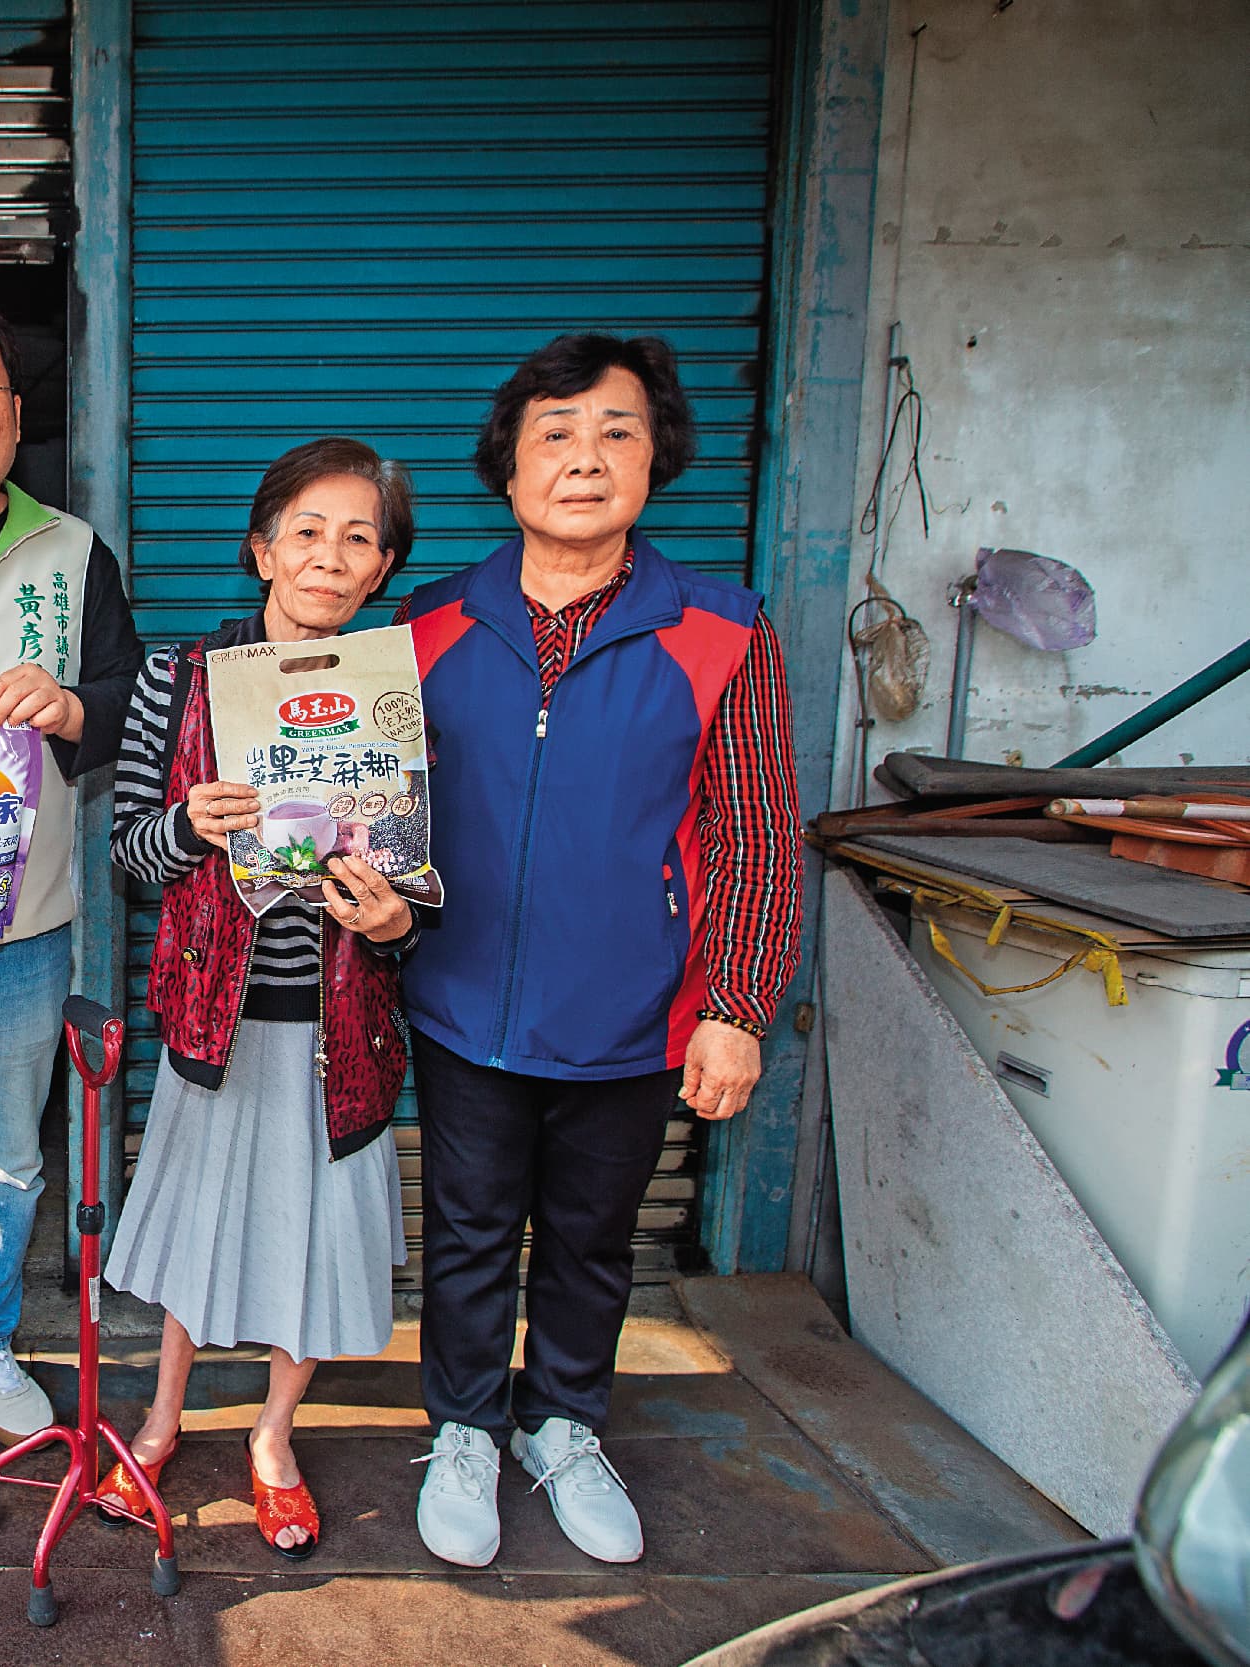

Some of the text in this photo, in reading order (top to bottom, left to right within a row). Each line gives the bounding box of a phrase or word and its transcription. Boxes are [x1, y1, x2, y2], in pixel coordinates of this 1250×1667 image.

[13, 582, 46, 668] 黃彥
[52, 571, 71, 681] 高雄市議員
[211, 646, 277, 664] GREENMAX
[288, 697, 350, 722] 馬玉山
[377, 696, 409, 715] 100%
[381, 703, 422, 730] 全天然
[288, 724, 351, 738] GREENMAX
[389, 718, 422, 738] NATURE
[267, 744, 400, 790] 黑芝麻糊
